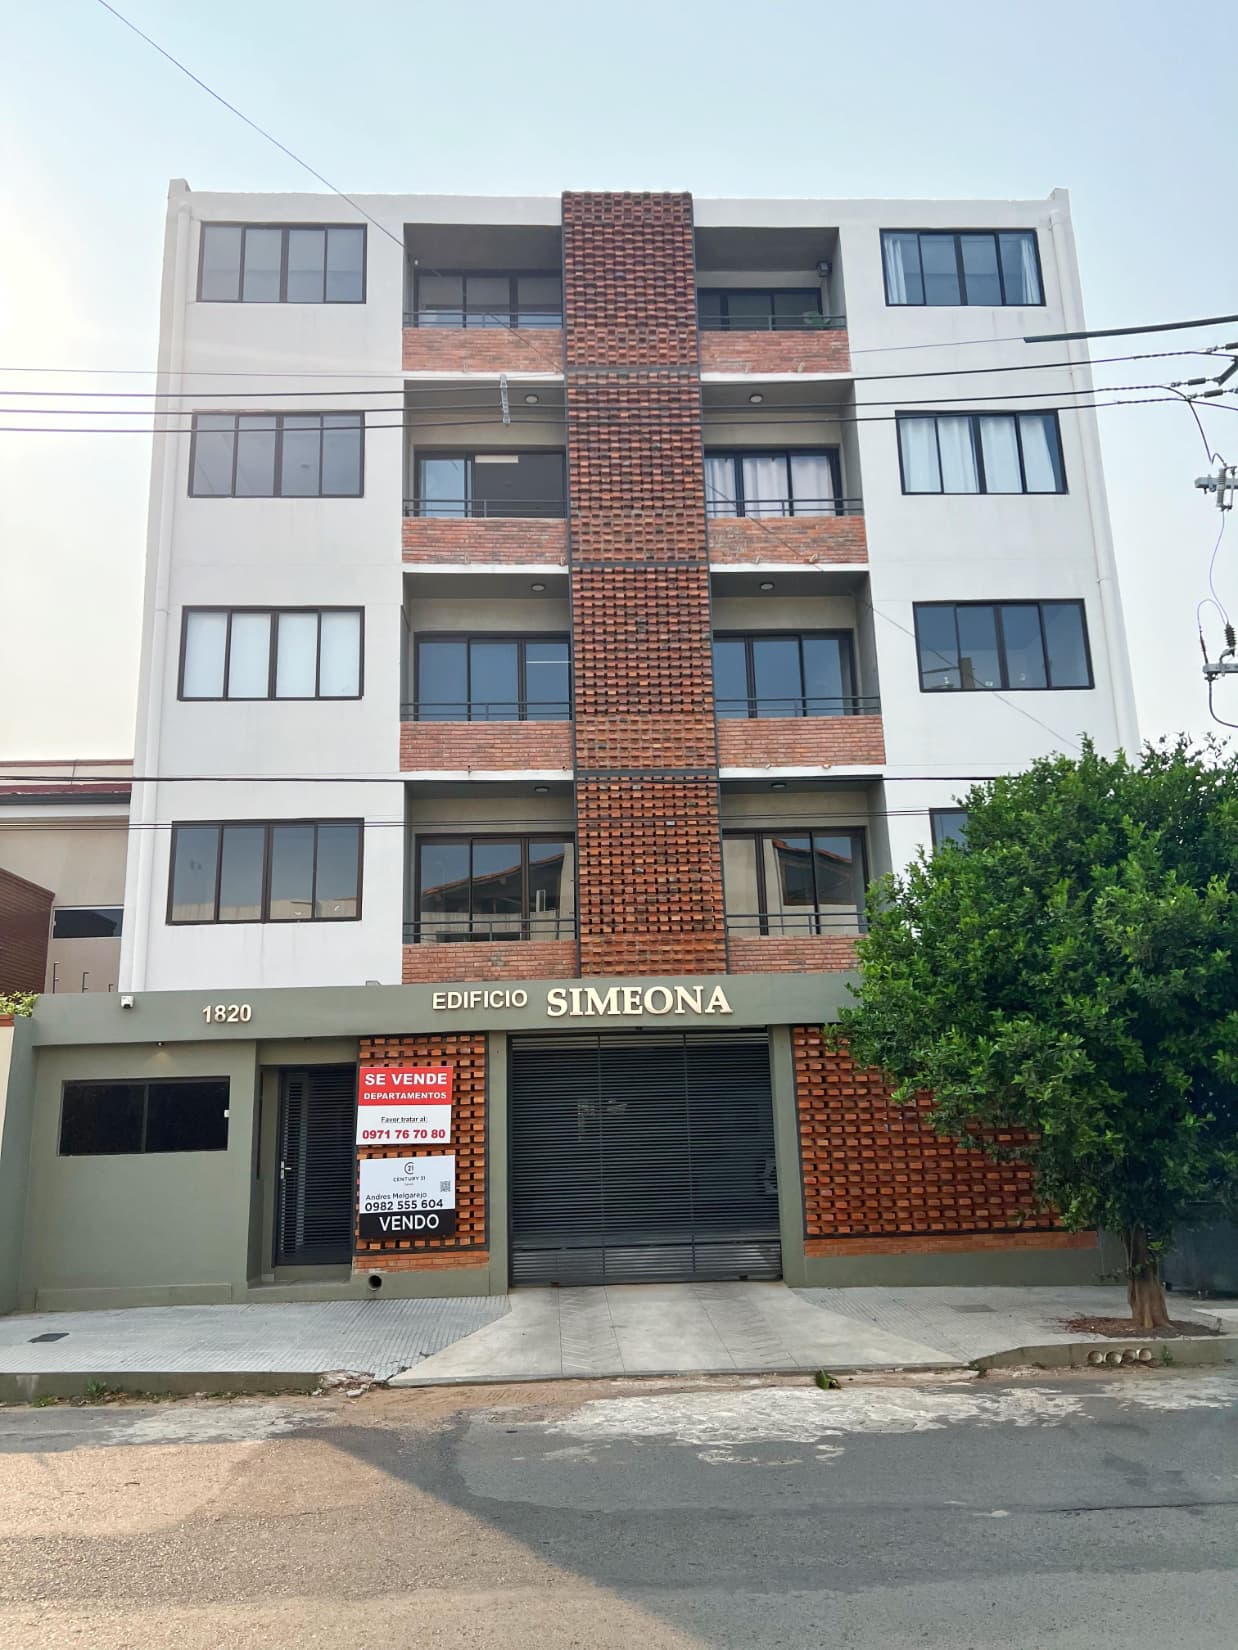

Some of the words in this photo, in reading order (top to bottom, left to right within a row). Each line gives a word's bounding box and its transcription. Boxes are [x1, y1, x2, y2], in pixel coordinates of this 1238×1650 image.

[432, 989, 528, 1010] EDIFICIO
[547, 985, 734, 1017] SIMEONA
[202, 1004, 252, 1024] 1820
[364, 1073, 387, 1086] SE
[391, 1072, 448, 1086] VENDE
[363, 1091, 447, 1100] DEPARTAMENTOS
[362, 1130, 391, 1139] 0971
[395, 1129, 410, 1139] 76
[413, 1129, 428, 1139] 70
[431, 1129, 446, 1139] 80
[366, 1193, 391, 1201] Andres
[365, 1201, 394, 1212] 0982
[397, 1200, 418, 1210] 555
[421, 1198, 444, 1209] 604
[379, 1213, 440, 1232] VENDO
